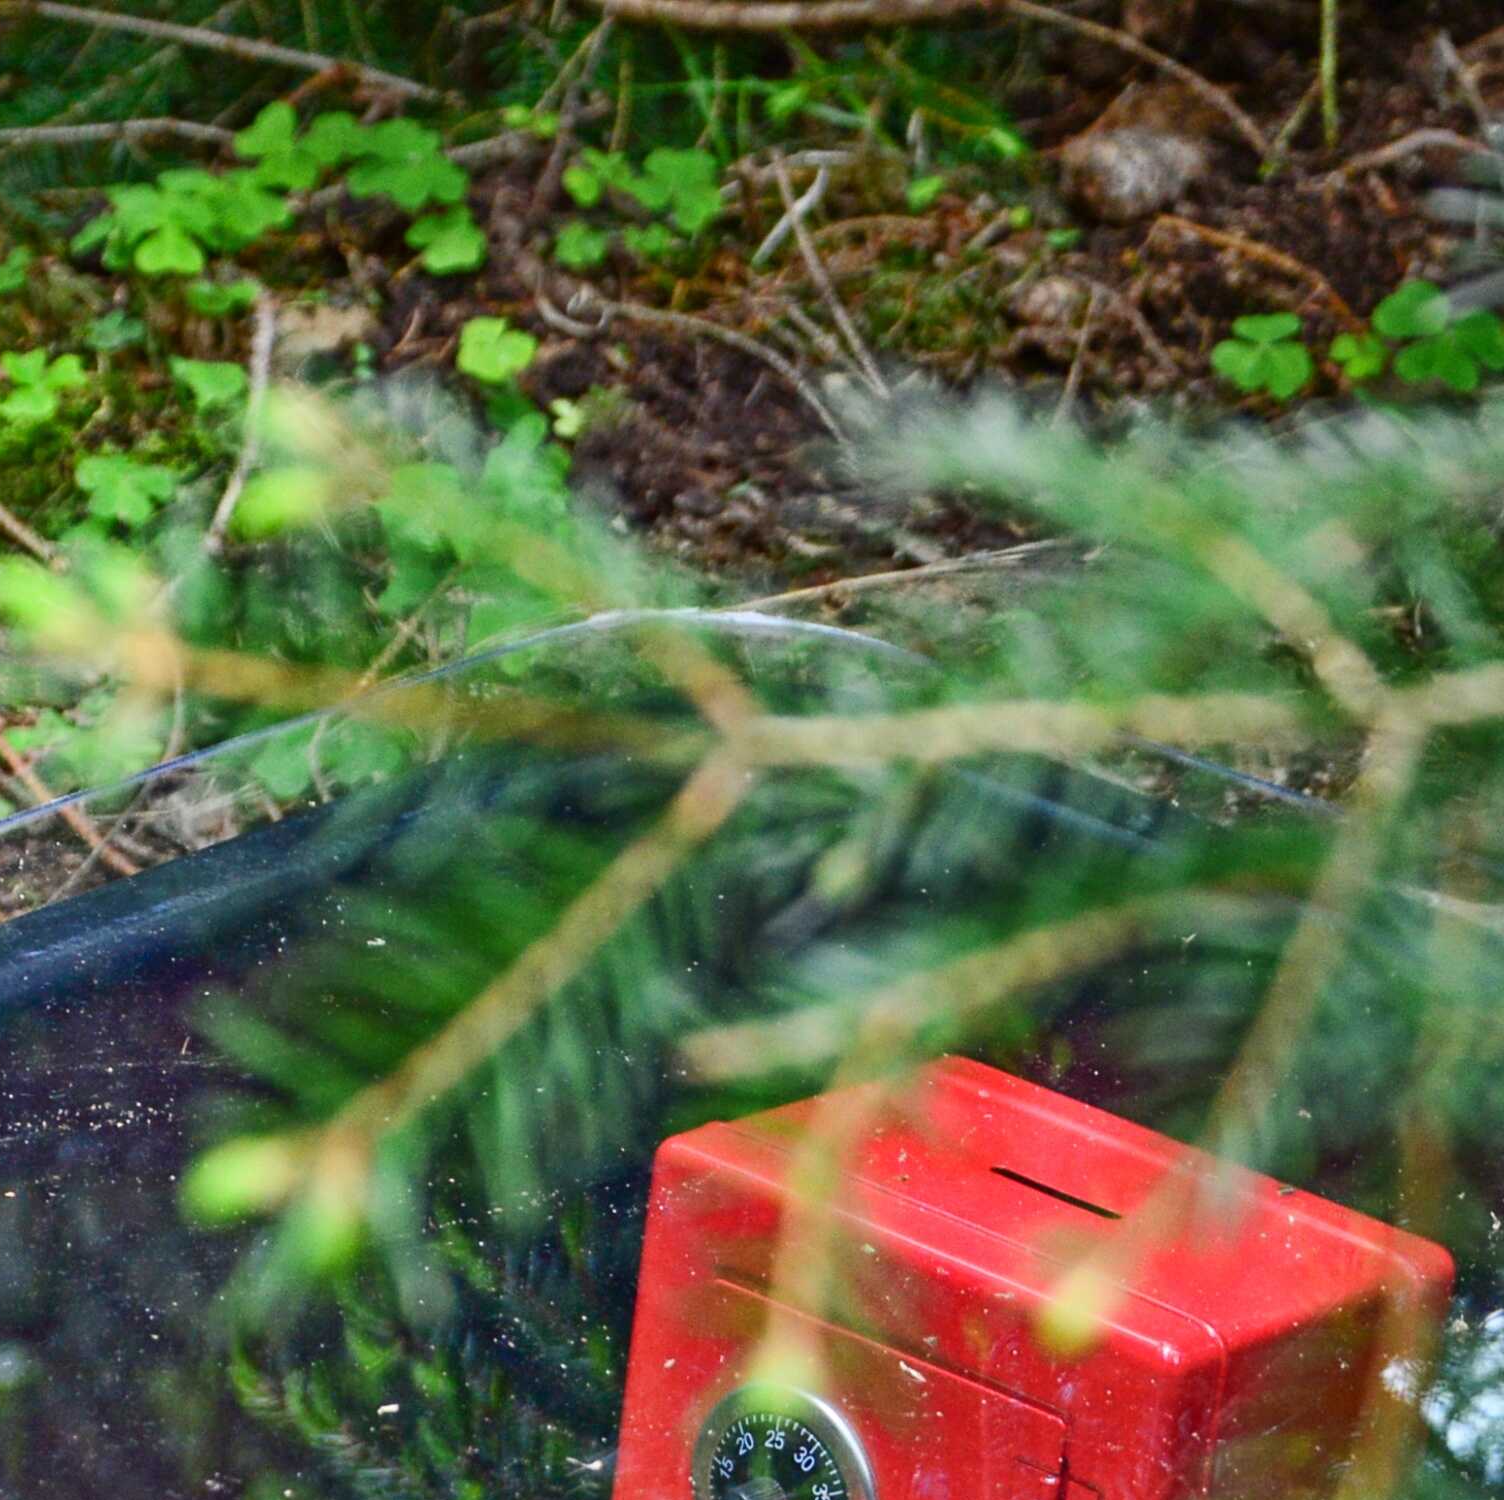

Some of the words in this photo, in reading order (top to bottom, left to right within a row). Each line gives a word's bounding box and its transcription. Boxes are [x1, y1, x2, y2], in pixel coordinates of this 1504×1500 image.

[736, 1432, 754, 1456] 20
[764, 1430, 785, 1450] 25
[719, 1456, 734, 1480] 15
[793, 1447, 815, 1473] 30
